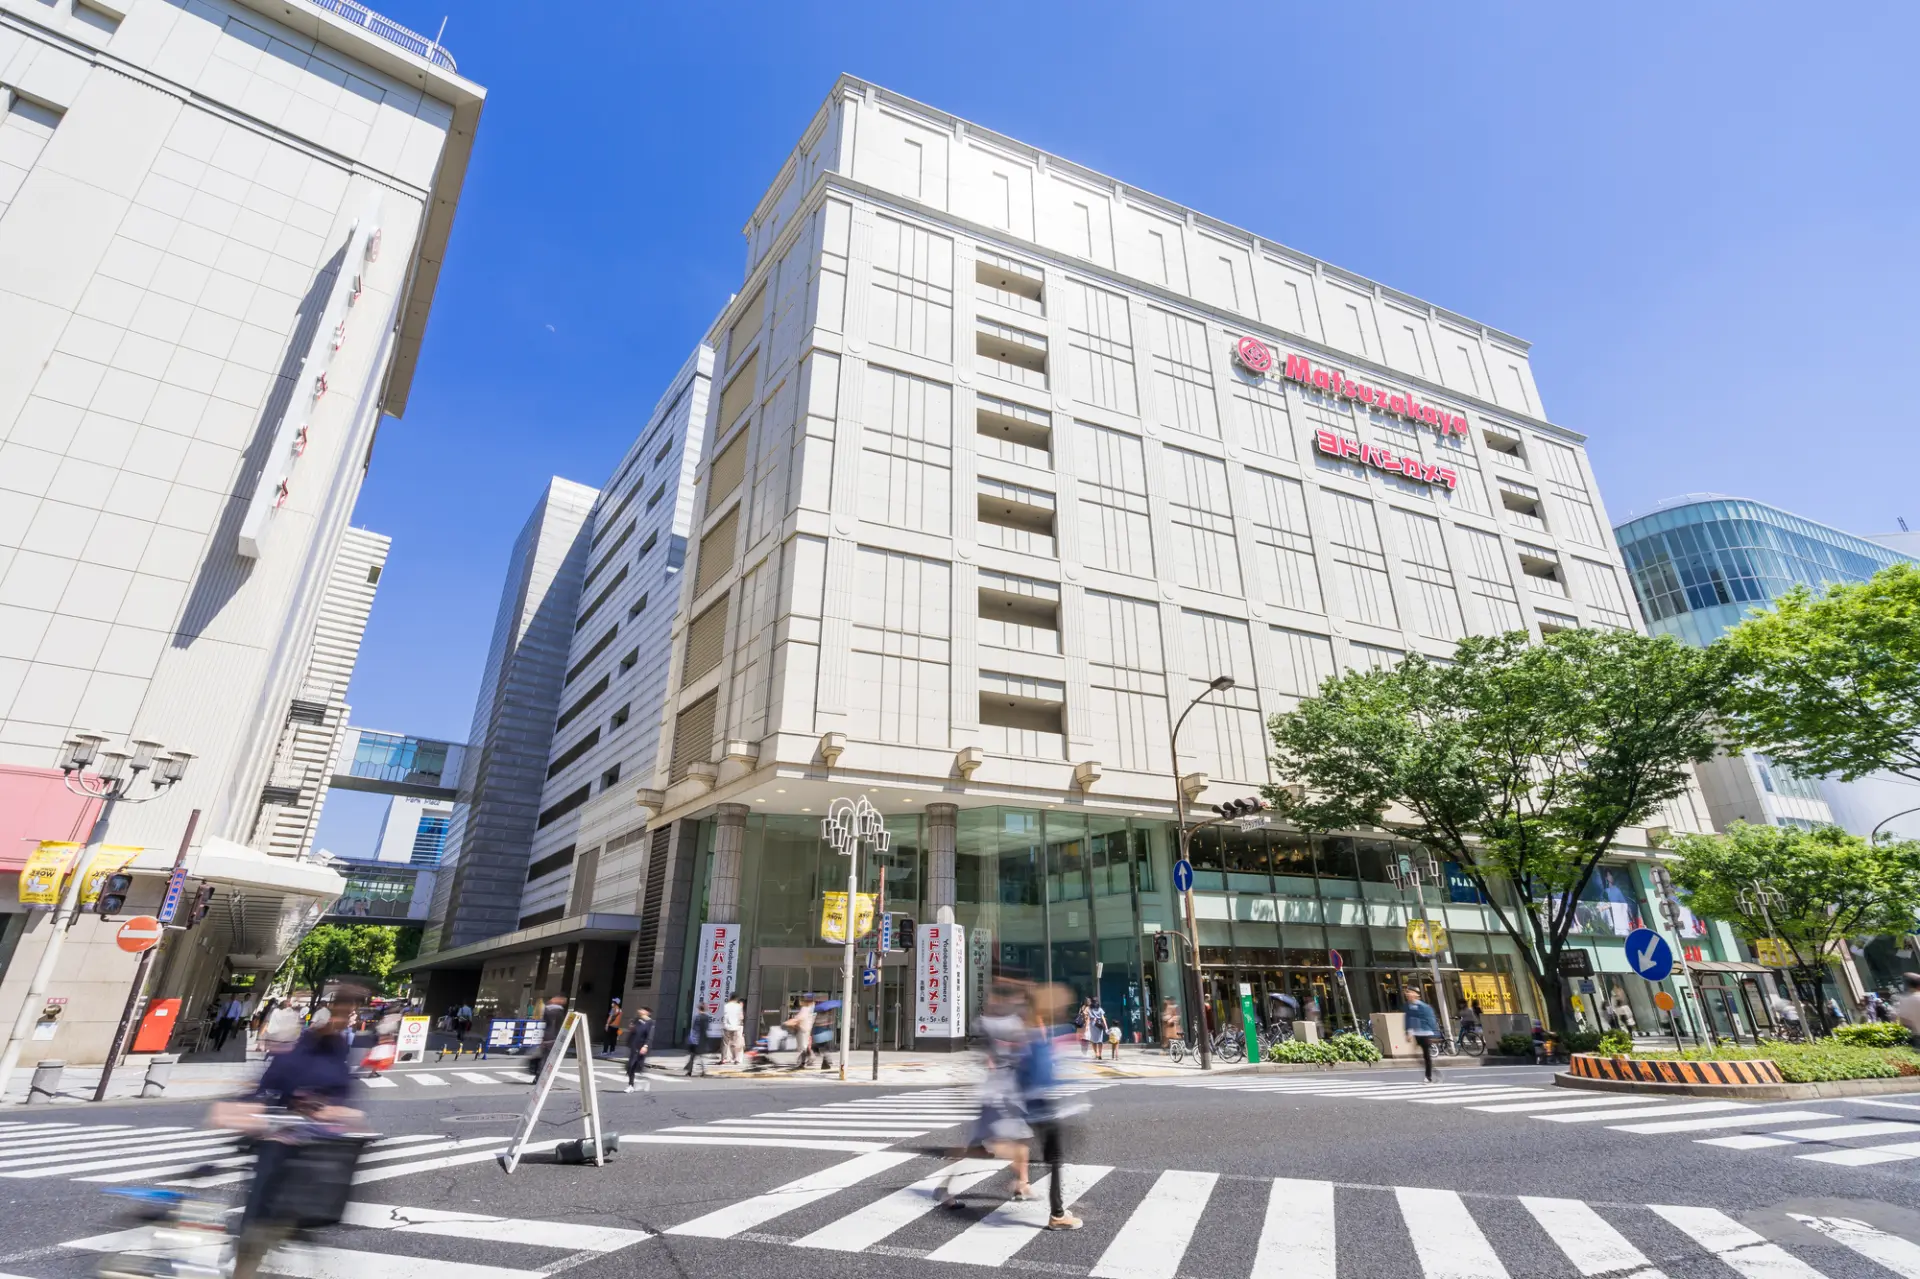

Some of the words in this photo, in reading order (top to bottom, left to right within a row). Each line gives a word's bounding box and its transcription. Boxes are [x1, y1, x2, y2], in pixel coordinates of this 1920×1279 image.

[1285, 354, 1468, 435] Matsuzakaya
[1316, 428, 1457, 489] ヨドバシカメラ
[708, 927, 727, 1013] ヨドバシカメラ
[726, 939, 736, 977] Yodobashi
[929, 928, 940, 1015] ヨドバシカメラ
